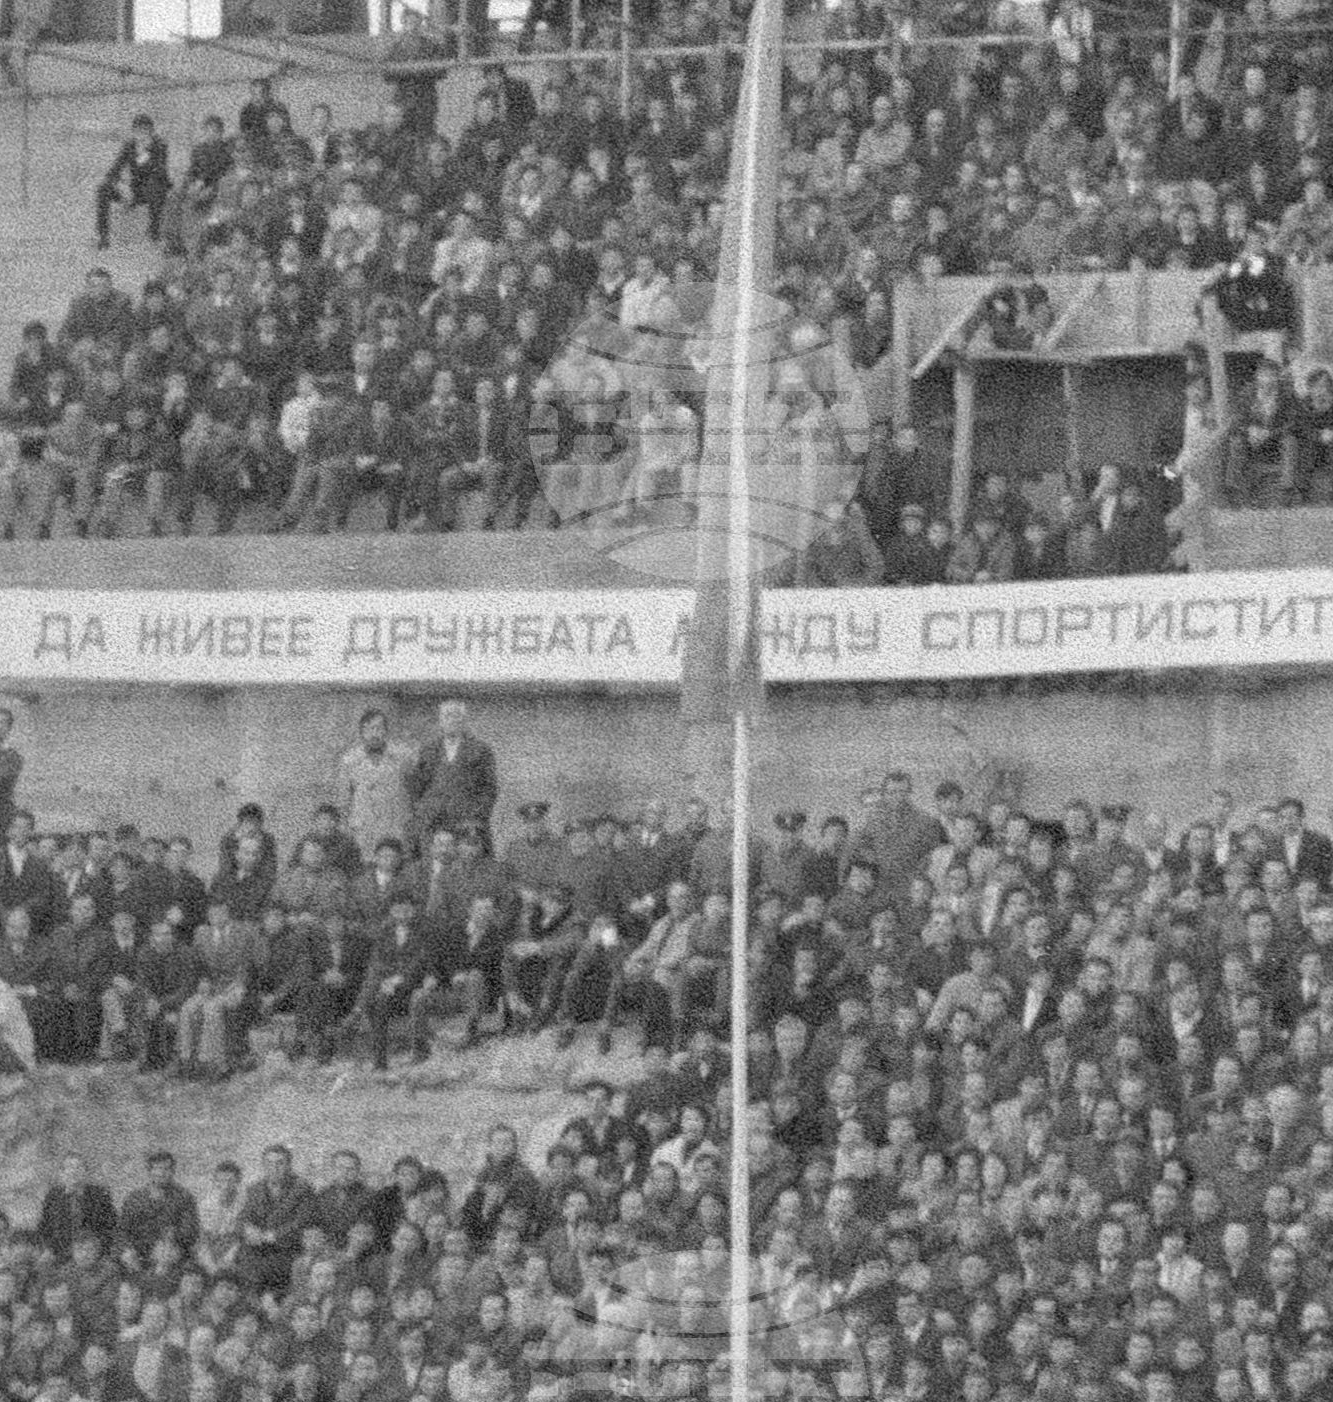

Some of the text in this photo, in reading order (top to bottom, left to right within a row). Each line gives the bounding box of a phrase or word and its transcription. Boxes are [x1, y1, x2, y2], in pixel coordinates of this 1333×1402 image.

[34, 613, 109, 660] ДА
[135, 613, 316, 660] ЖИВЕЕ
[342, 612, 637, 664] ДРУЖБАТА
